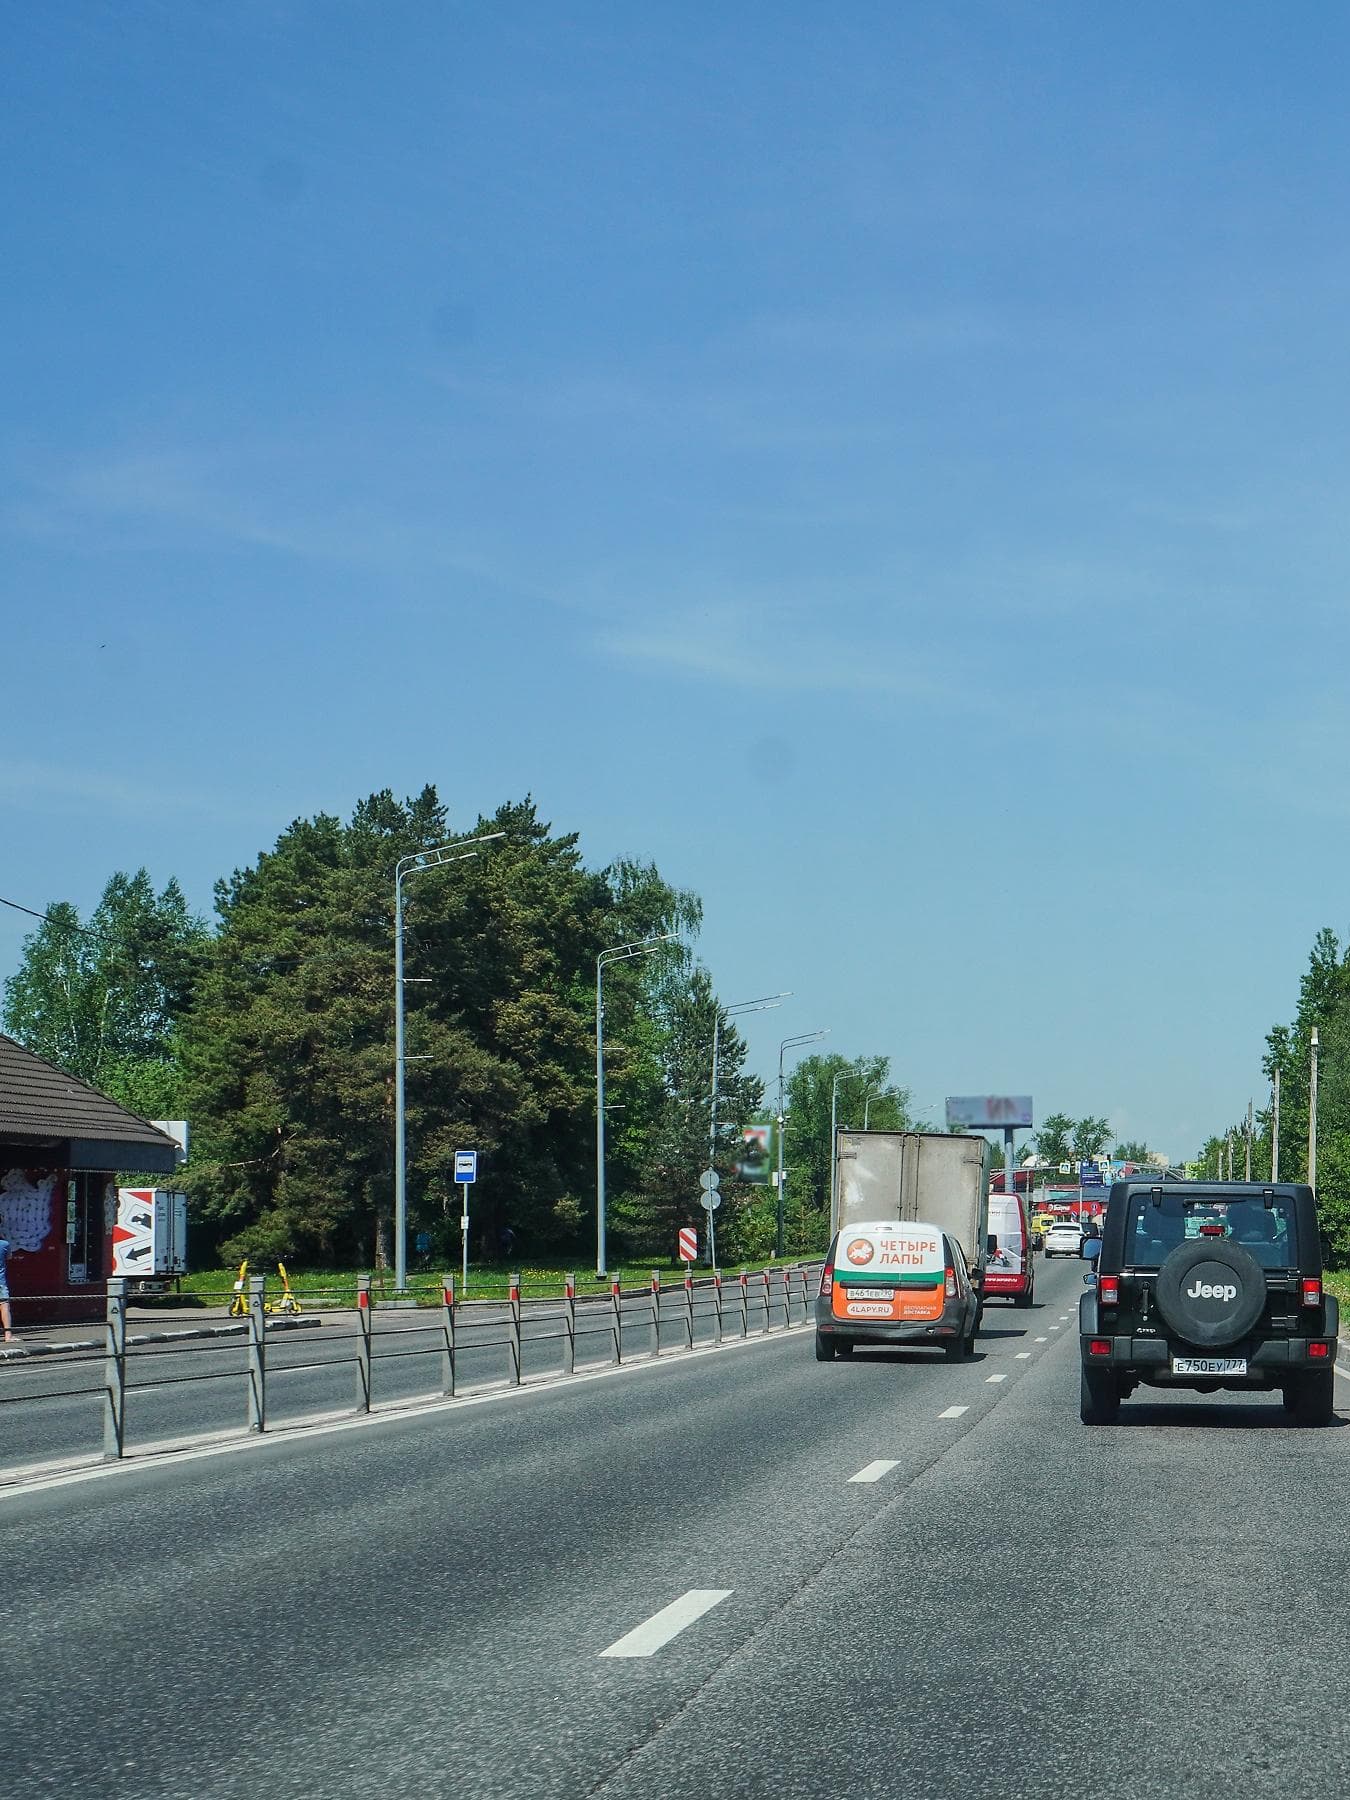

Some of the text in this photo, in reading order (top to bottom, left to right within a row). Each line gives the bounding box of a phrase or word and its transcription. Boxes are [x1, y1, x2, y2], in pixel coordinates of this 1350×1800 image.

[879, 1240, 937, 1253] ЧЕТЫРЕ
[879, 1253, 924, 1265] ЛАПЫ
[1187, 1280, 1237, 1302] Jeep
